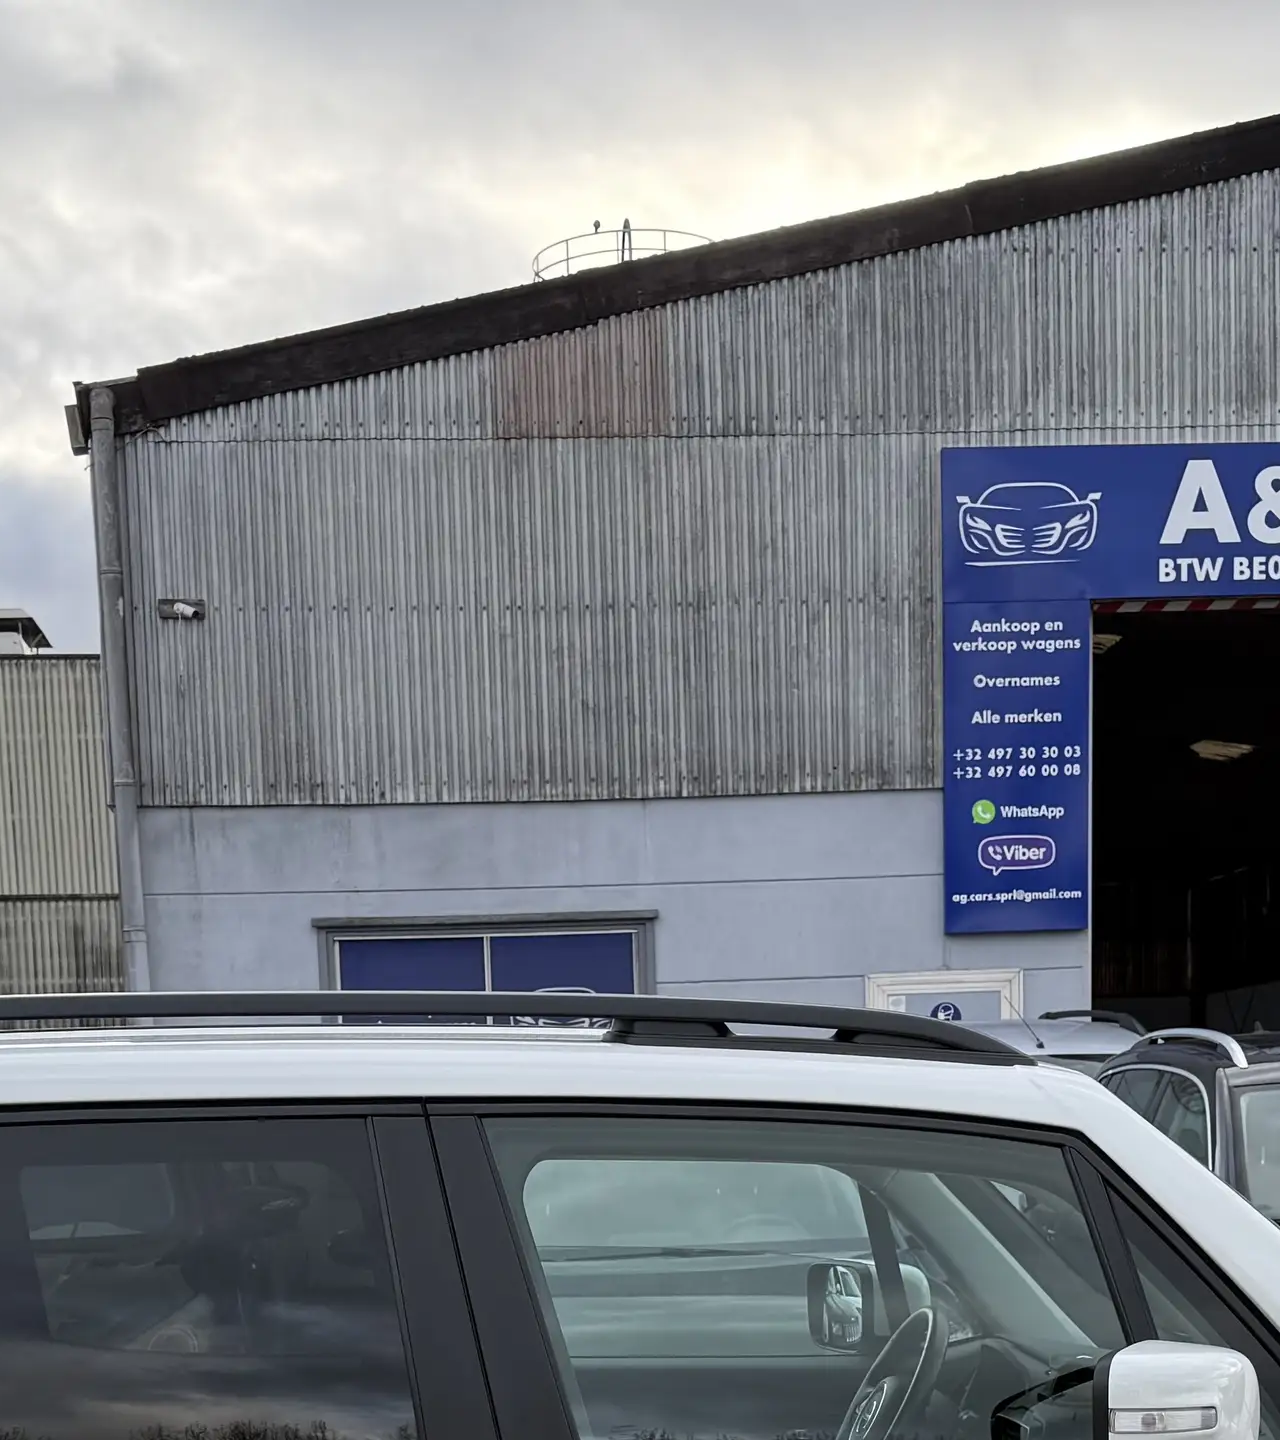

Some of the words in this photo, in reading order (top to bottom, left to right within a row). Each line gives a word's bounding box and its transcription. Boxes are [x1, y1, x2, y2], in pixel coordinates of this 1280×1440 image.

[1158, 557, 1223, 583] BTW
[970, 618, 1040, 634] Aankoop
[1044, 620, 1063, 632] en
[953, 636, 1017, 654] verkoop
[1021, 638, 1081, 652] wagens
[973, 674, 1061, 688] Overnames
[971, 709, 1001, 724] Alle
[1005, 708, 1062, 723] merken
[953, 748, 982, 761] +32
[987, 748, 1013, 760] 497
[1019, 747, 1036, 759] 30
[1041, 746, 1058, 758] 30
[1063, 746, 1081, 758] 03
[953, 766, 982, 780] +32
[987, 766, 1013, 778] 497
[1019, 766, 1036, 778] 60
[1041, 764, 1058, 776] 00
[1063, 764, 1081, 776] 08
[1000, 804, 1065, 820] WhatsApp
[1003, 845, 1047, 861] Viber
